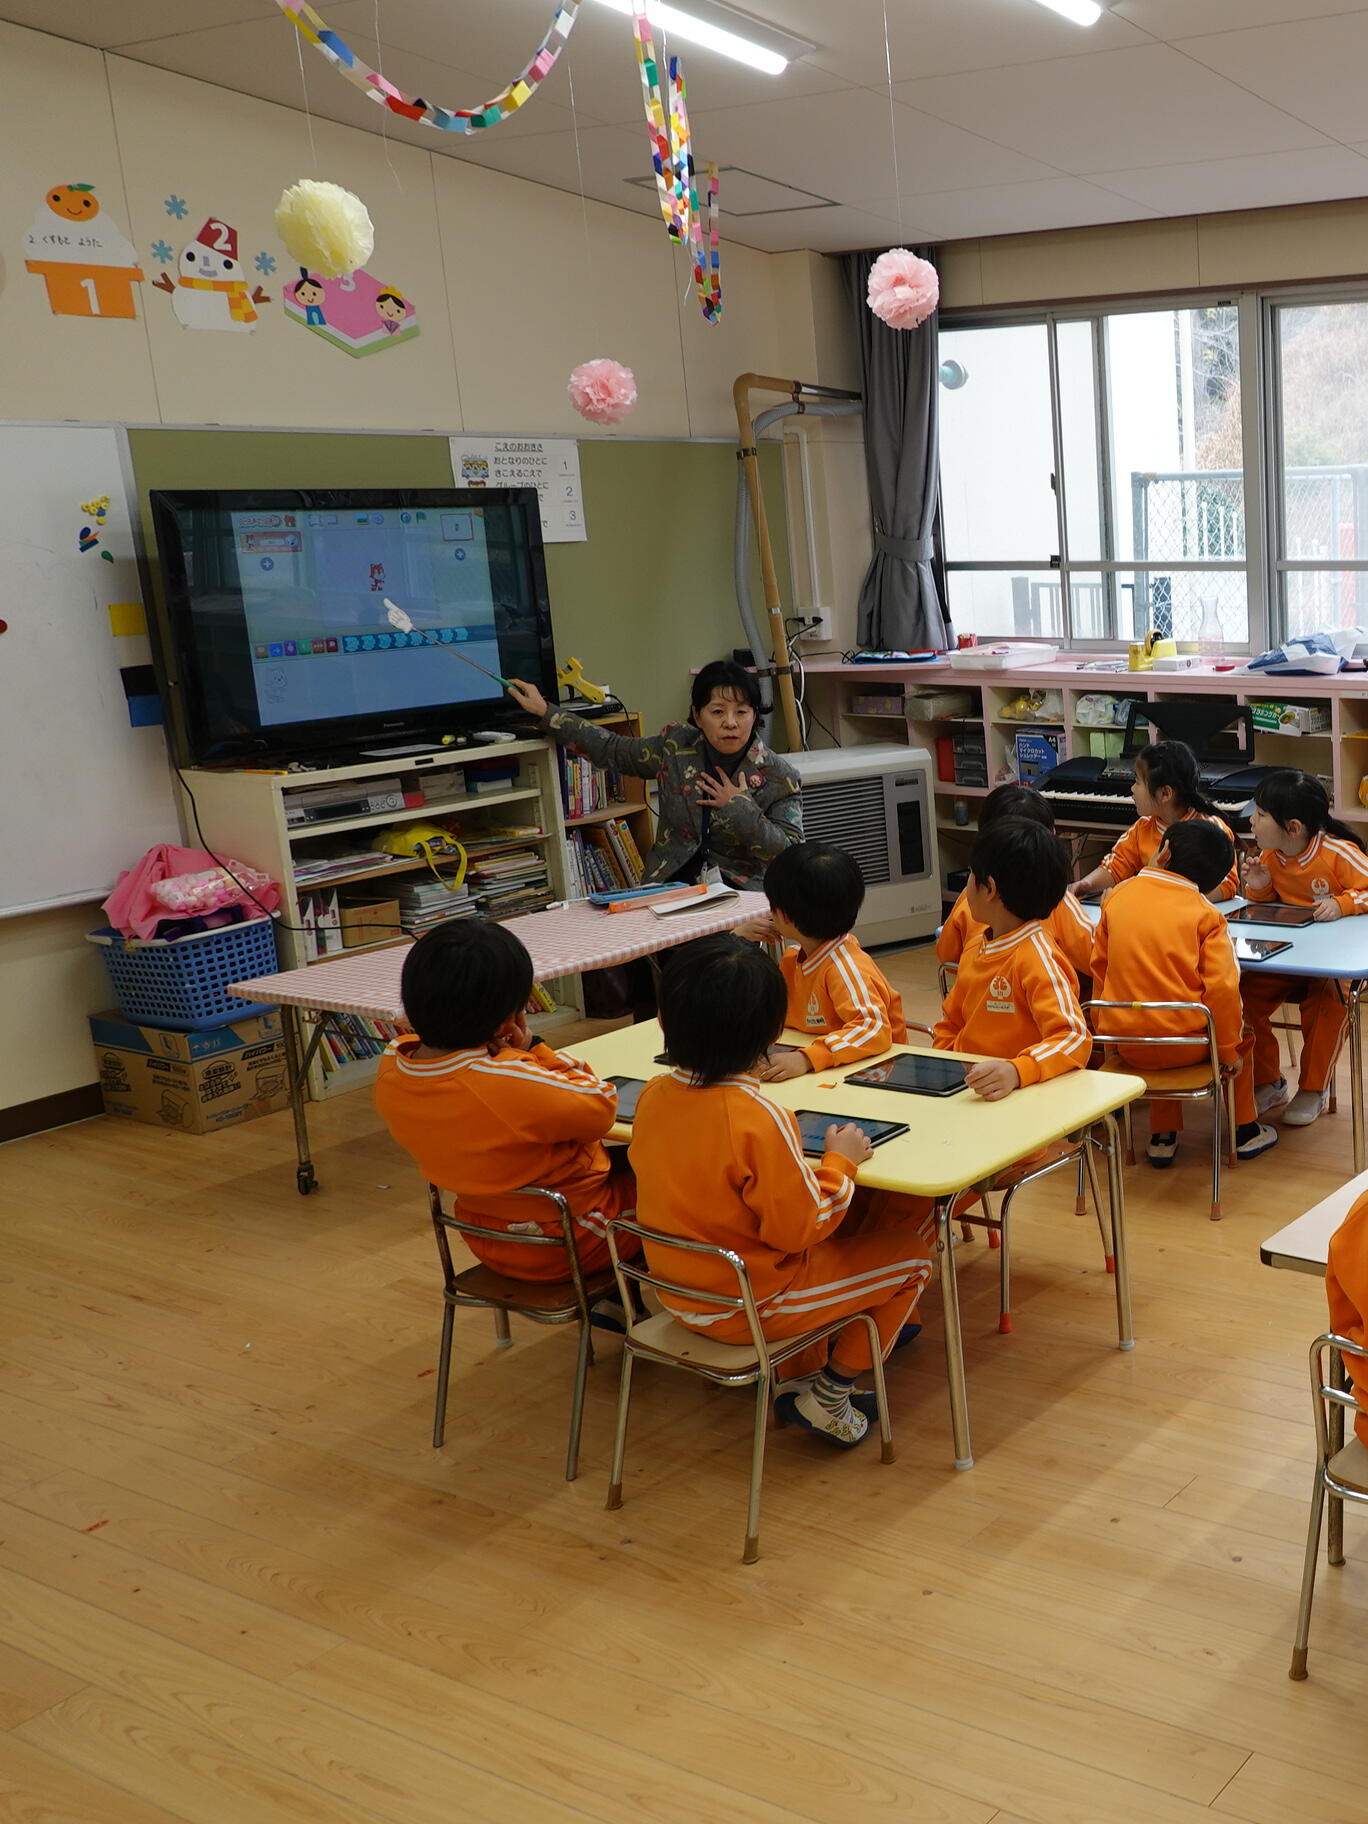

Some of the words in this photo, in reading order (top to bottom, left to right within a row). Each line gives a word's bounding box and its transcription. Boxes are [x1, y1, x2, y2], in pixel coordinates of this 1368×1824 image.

[209, 222, 232, 251] 2
[80, 278, 101, 315] 1
[495, 442, 544, 452] こえのおおきさ
[494, 457, 548, 466] おとなりのひとに
[563, 461, 568, 471] 1
[495, 469, 543, 478] きこえるこえで
[495, 481, 549, 490] グループのひとに
[565, 487, 574, 497] 2
[569, 510, 577, 521] 3
